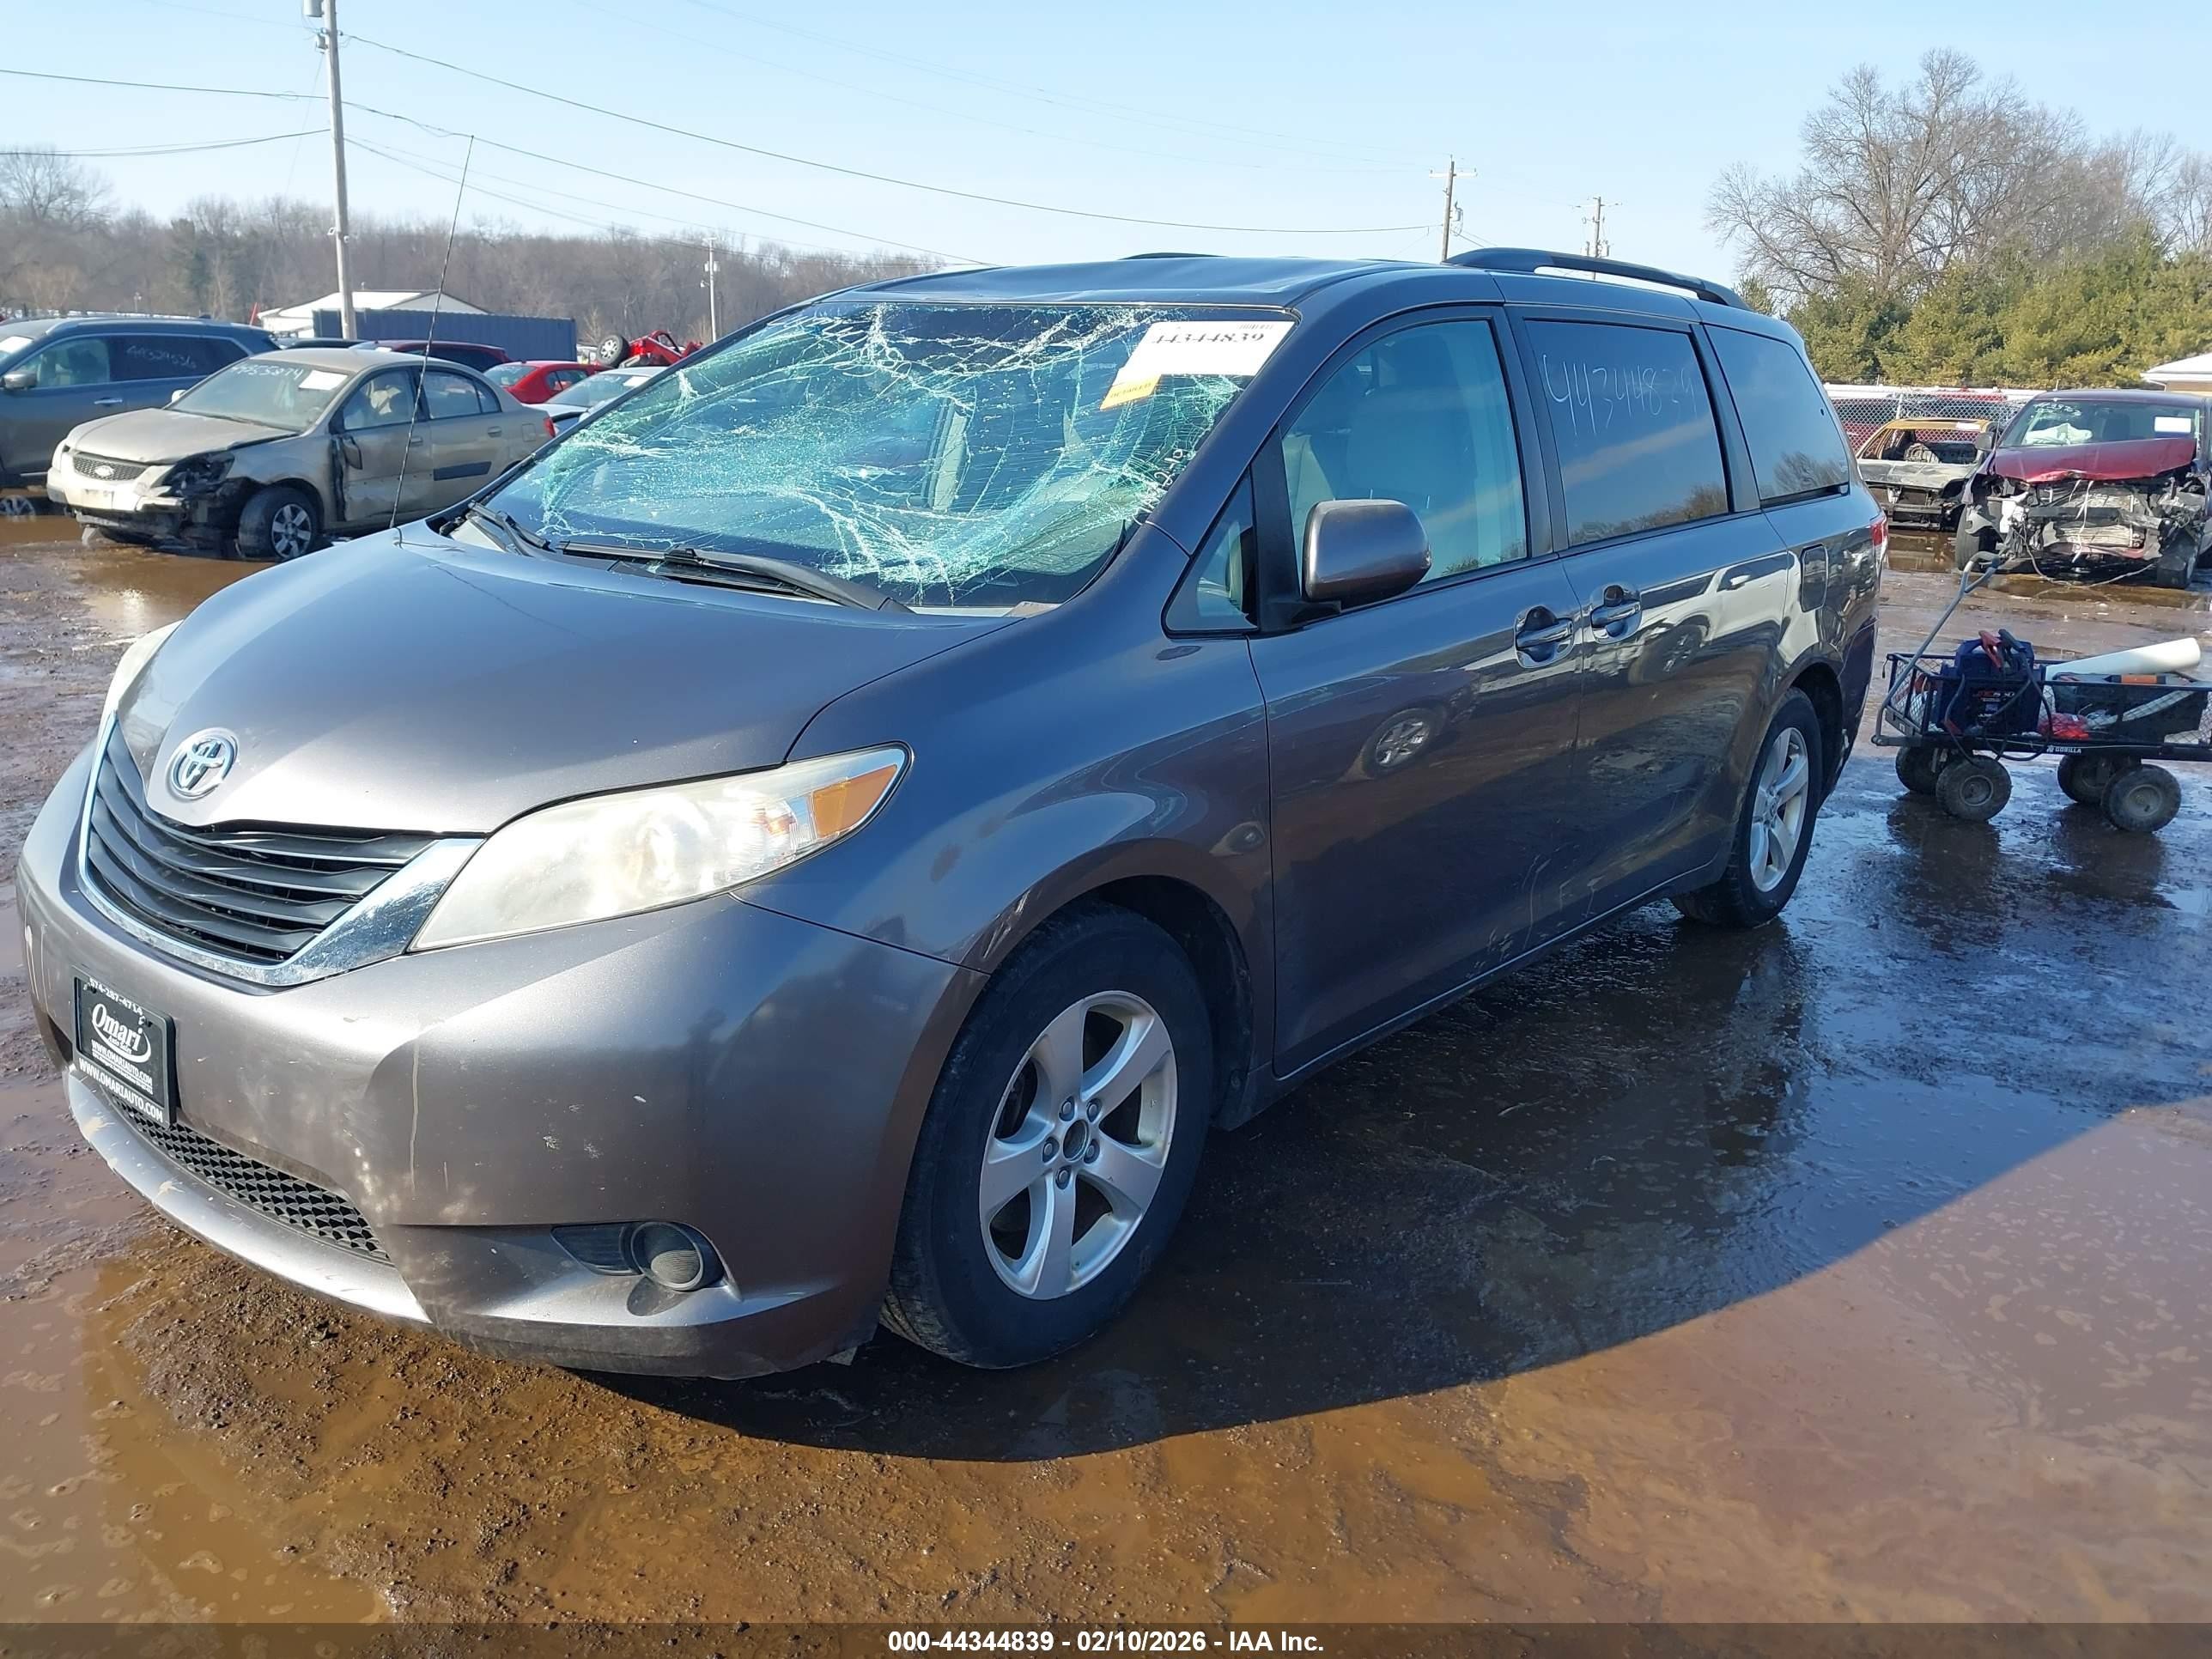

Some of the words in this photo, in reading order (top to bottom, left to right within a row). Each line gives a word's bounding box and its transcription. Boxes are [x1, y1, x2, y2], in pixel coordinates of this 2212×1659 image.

[92, 1003, 143, 1051] Omari
[91, 1039, 154, 1087] WWW.OMARIAUTO.COM
[78, 1057, 164, 1123] WWW.OMARIAUTO.COM
